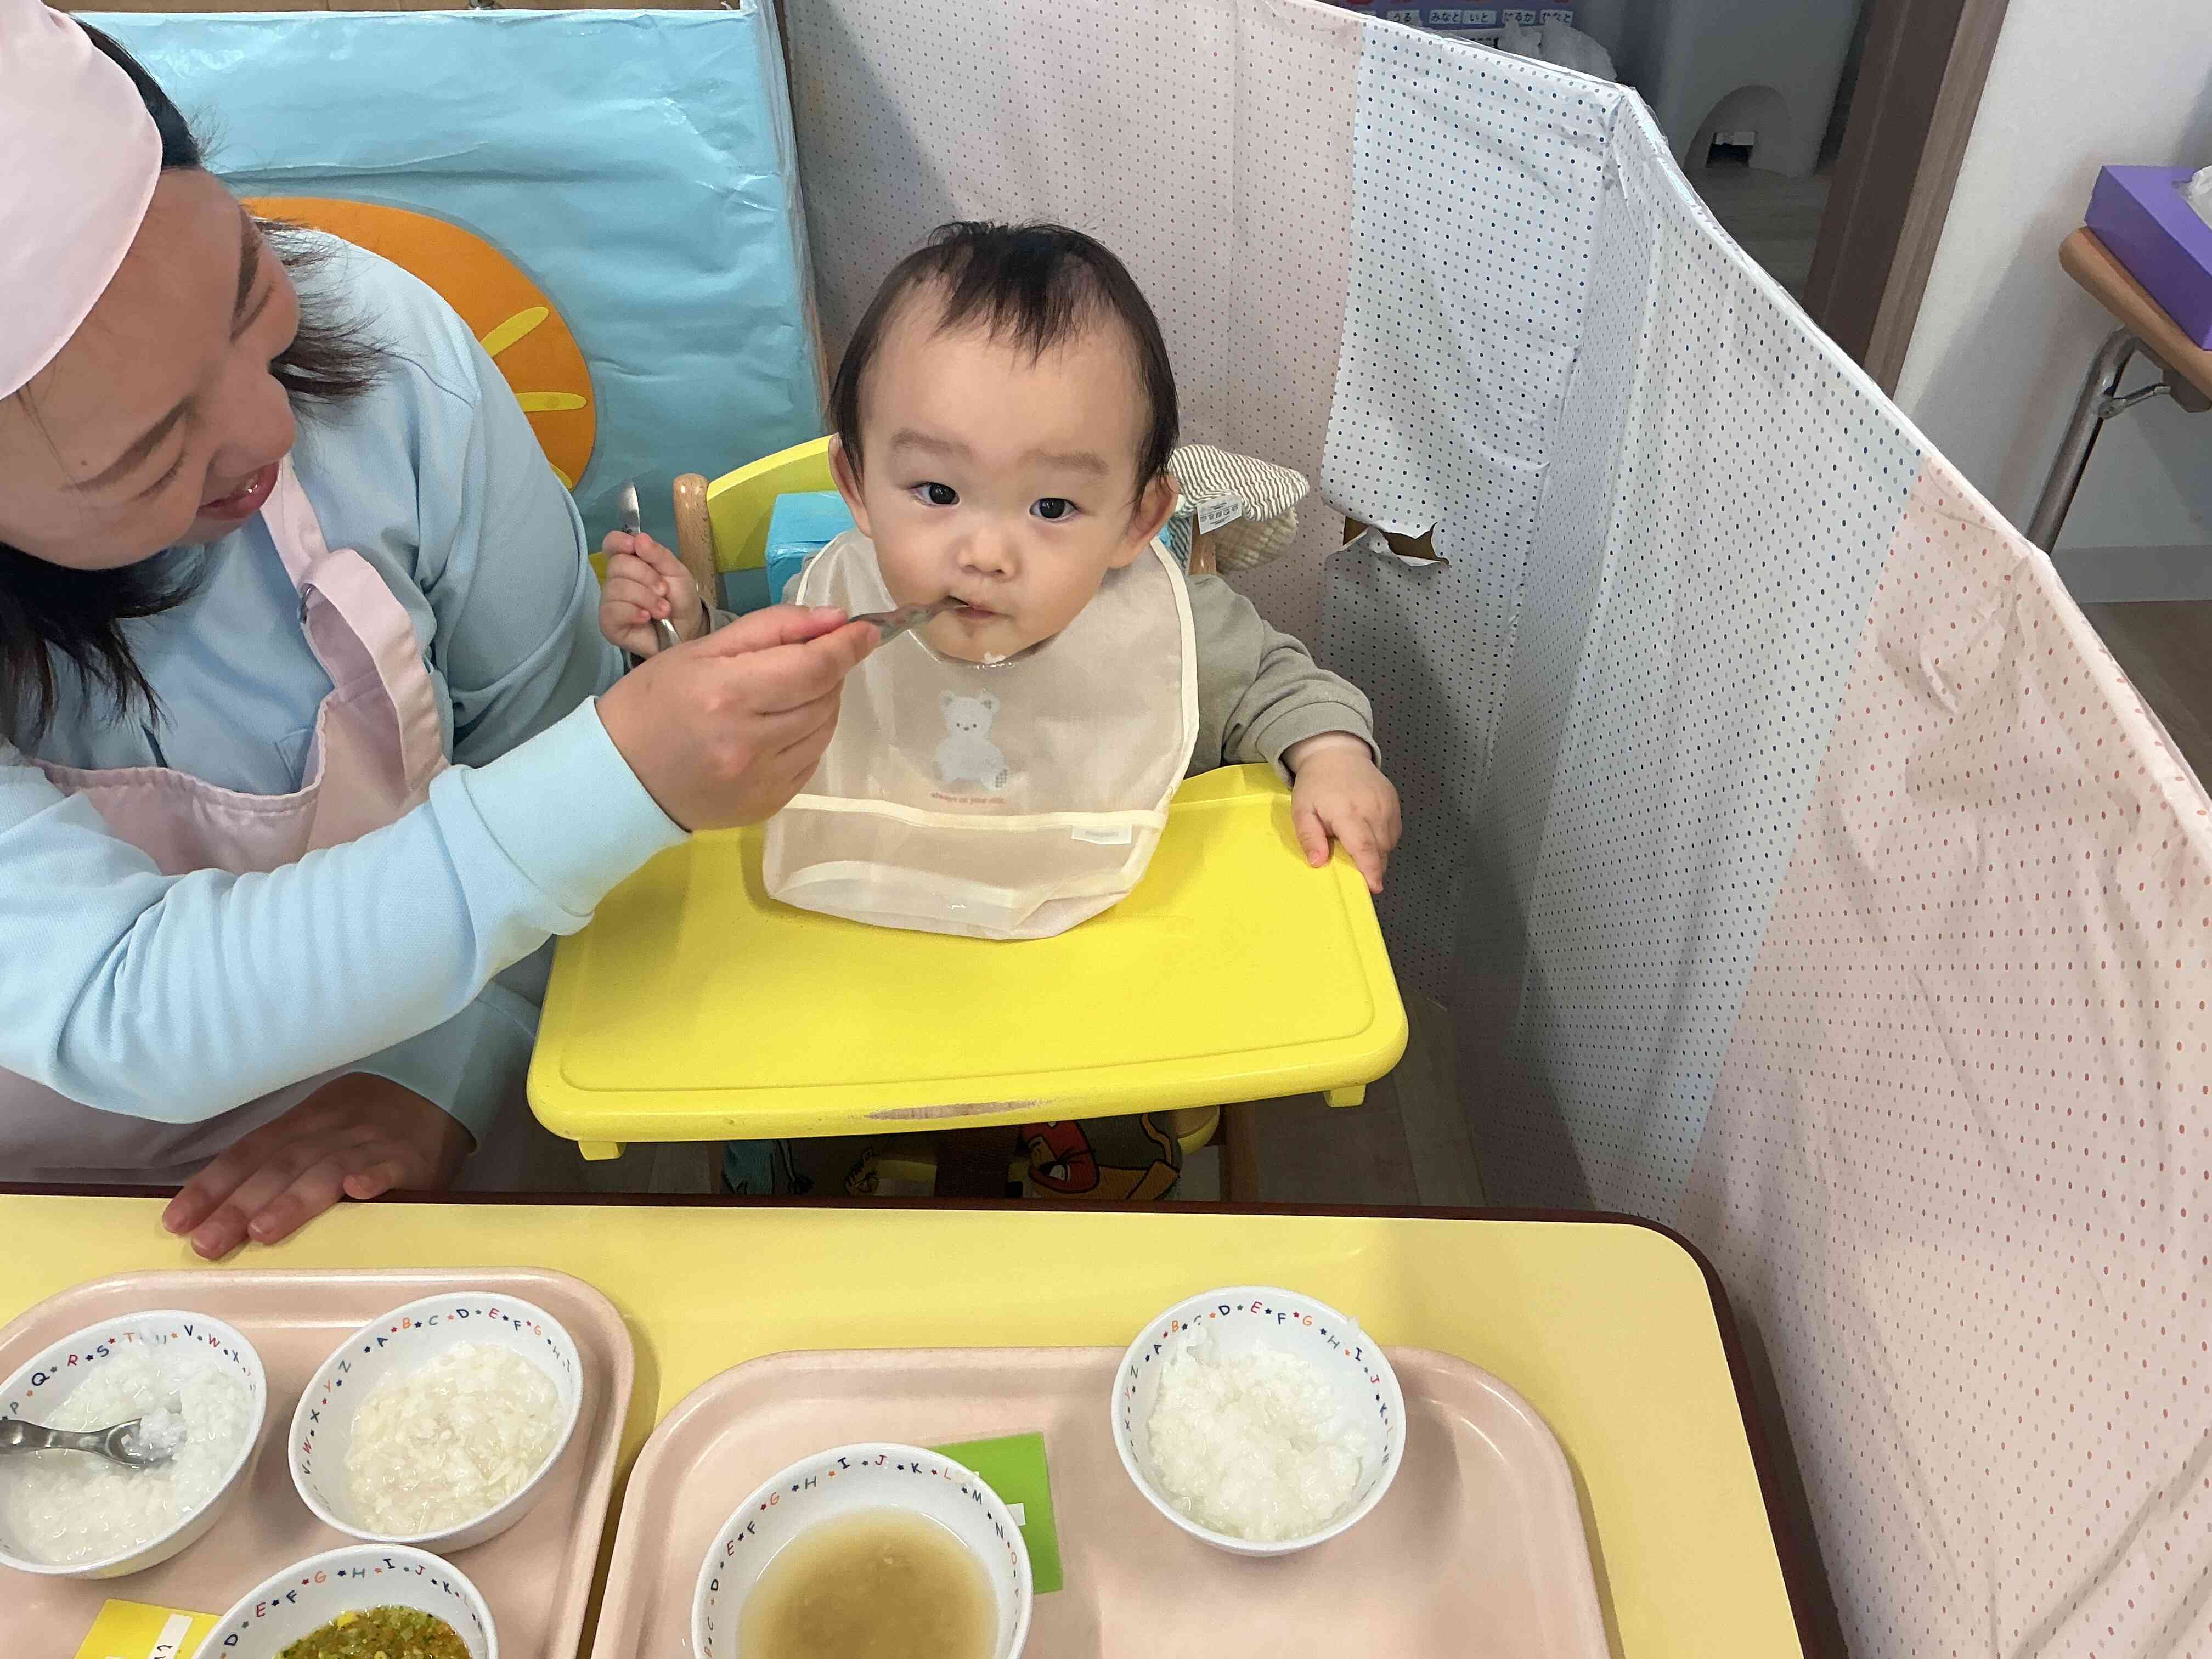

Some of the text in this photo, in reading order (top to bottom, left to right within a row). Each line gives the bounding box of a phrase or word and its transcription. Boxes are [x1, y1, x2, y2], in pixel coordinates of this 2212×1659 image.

[1431, 12, 1459, 22] みなと
[10, 1402, 19, 1414] P
[32, 1373, 50, 1386] Q
[67, 1355, 78, 1366] R
[97, 1345, 109, 1357] S
[123, 1332, 135, 1343] T
[184, 1325, 193, 1336] V
[209, 1334, 220, 1347] W
[232, 1350, 239, 1363] X
[311, 1409, 320, 1423] X
[338, 1361, 351, 1373] Z
[377, 1338, 388, 1347] A
[403, 1317, 411, 1329] B
[429, 1315, 438, 1325] C
[456, 1309, 469, 1318] D
[489, 1308, 499, 1319] E
[514, 1321, 521, 1330] F
[534, 1325, 541, 1335] G
[1131, 1365, 1138, 1378] Z
[1154, 1345, 1161, 1355] A
[1172, 1321, 1179, 1332] B
[1218, 1305, 1230, 1315] D
[1251, 1301, 1262, 1313] E
[1278, 1313, 1286, 1324] F
[1302, 1315, 1312, 1326] G
[1327, 1335, 1340, 1350] H
[1355, 1347, 1362, 1361] I
[1370, 1375, 1379, 1383] J
[711, 1579, 718, 1591] D
[727, 1540, 734, 1556] E
[747, 1521, 755, 1534] F
[770, 1492, 780, 1505] G
[805, 1476, 816, 1489] H
[838, 1458, 850, 1469] I
[875, 1455, 887, 1465] J
[911, 1463, 922, 1473] K
[944, 1468, 951, 1480] L
[972, 1490, 981, 1504] M
[996, 1522, 1003, 1539] N
[224, 1634, 238, 1646] D
[256, 1602, 266, 1617] E
[286, 1590, 297, 1603] F
[314, 1571, 326, 1583] G
[352, 1568, 365, 1578] H
[383, 1559, 395, 1569] I
[415, 1565, 425, 1575] J
[443, 1581, 451, 1594] K
